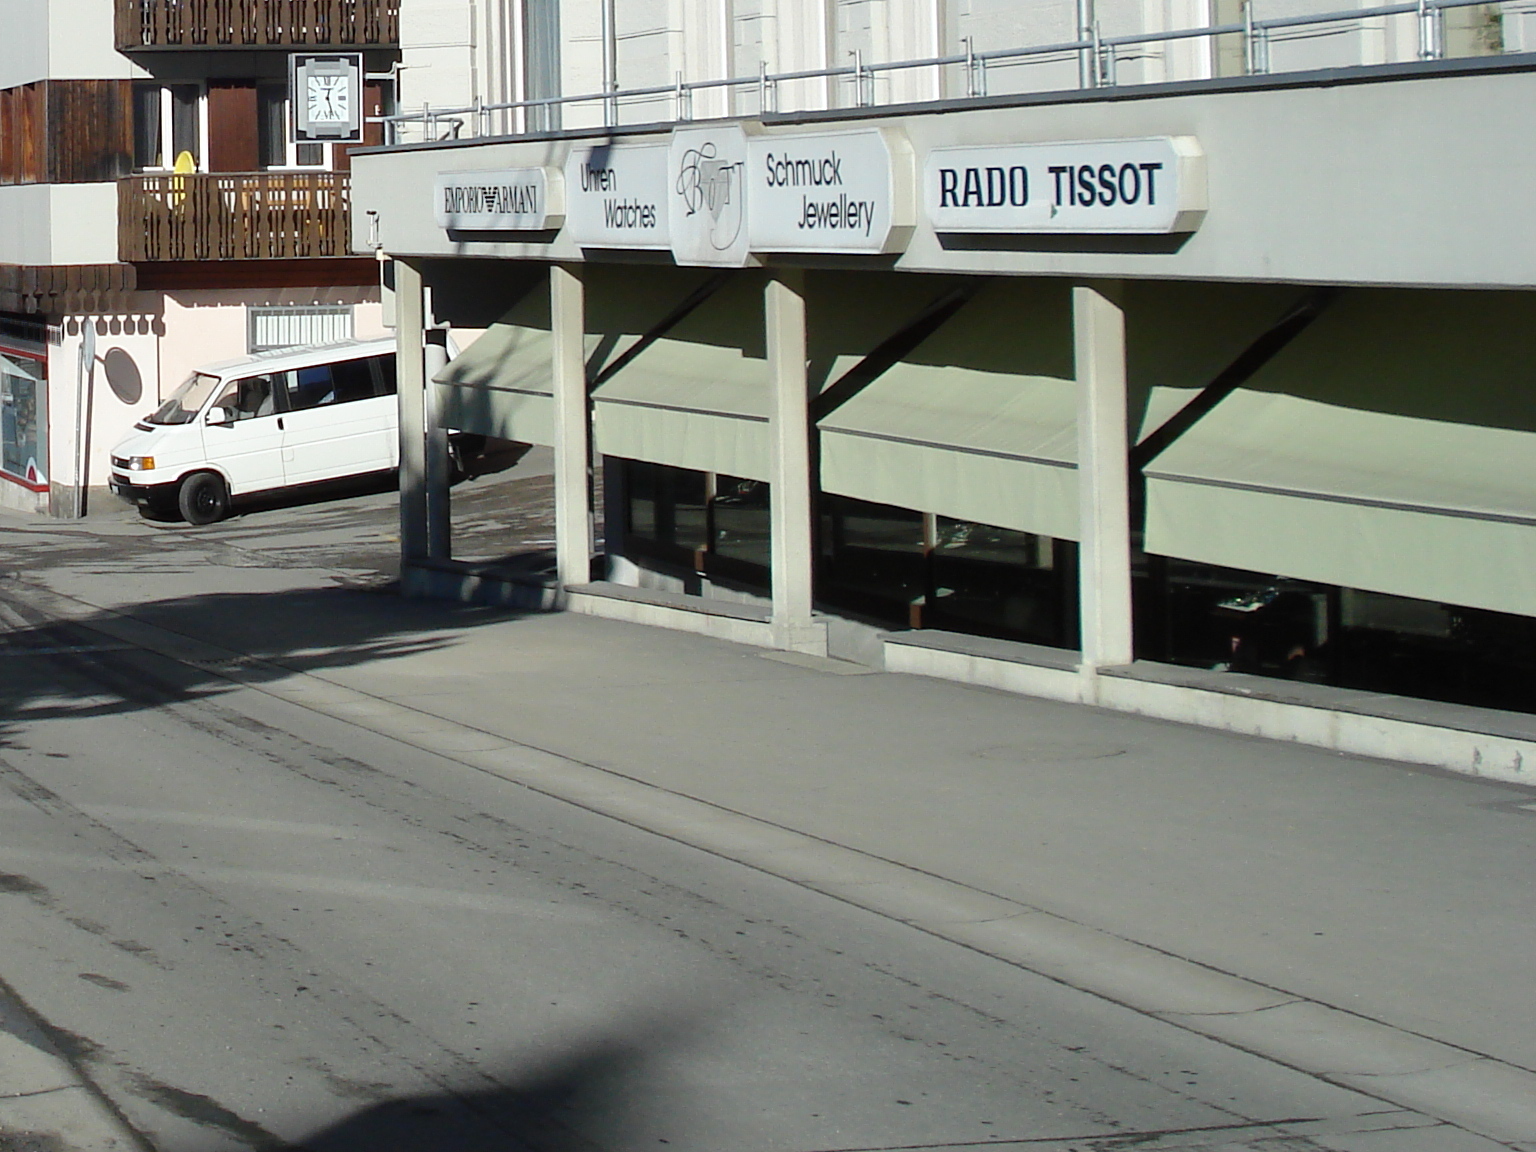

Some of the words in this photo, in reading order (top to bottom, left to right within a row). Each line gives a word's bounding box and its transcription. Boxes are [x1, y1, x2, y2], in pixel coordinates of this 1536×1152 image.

[580, 162, 617, 193] Uhren
[766, 150, 843, 188] Schmuck
[939, 166, 1029, 208] RADO
[1047, 162, 1163, 207] TISSOT
[444, 186, 484, 214] EMPORIO
[494, 185, 537, 214] ARMANI
[604, 198, 657, 229] Watches
[797, 193, 875, 238] Jewellery
